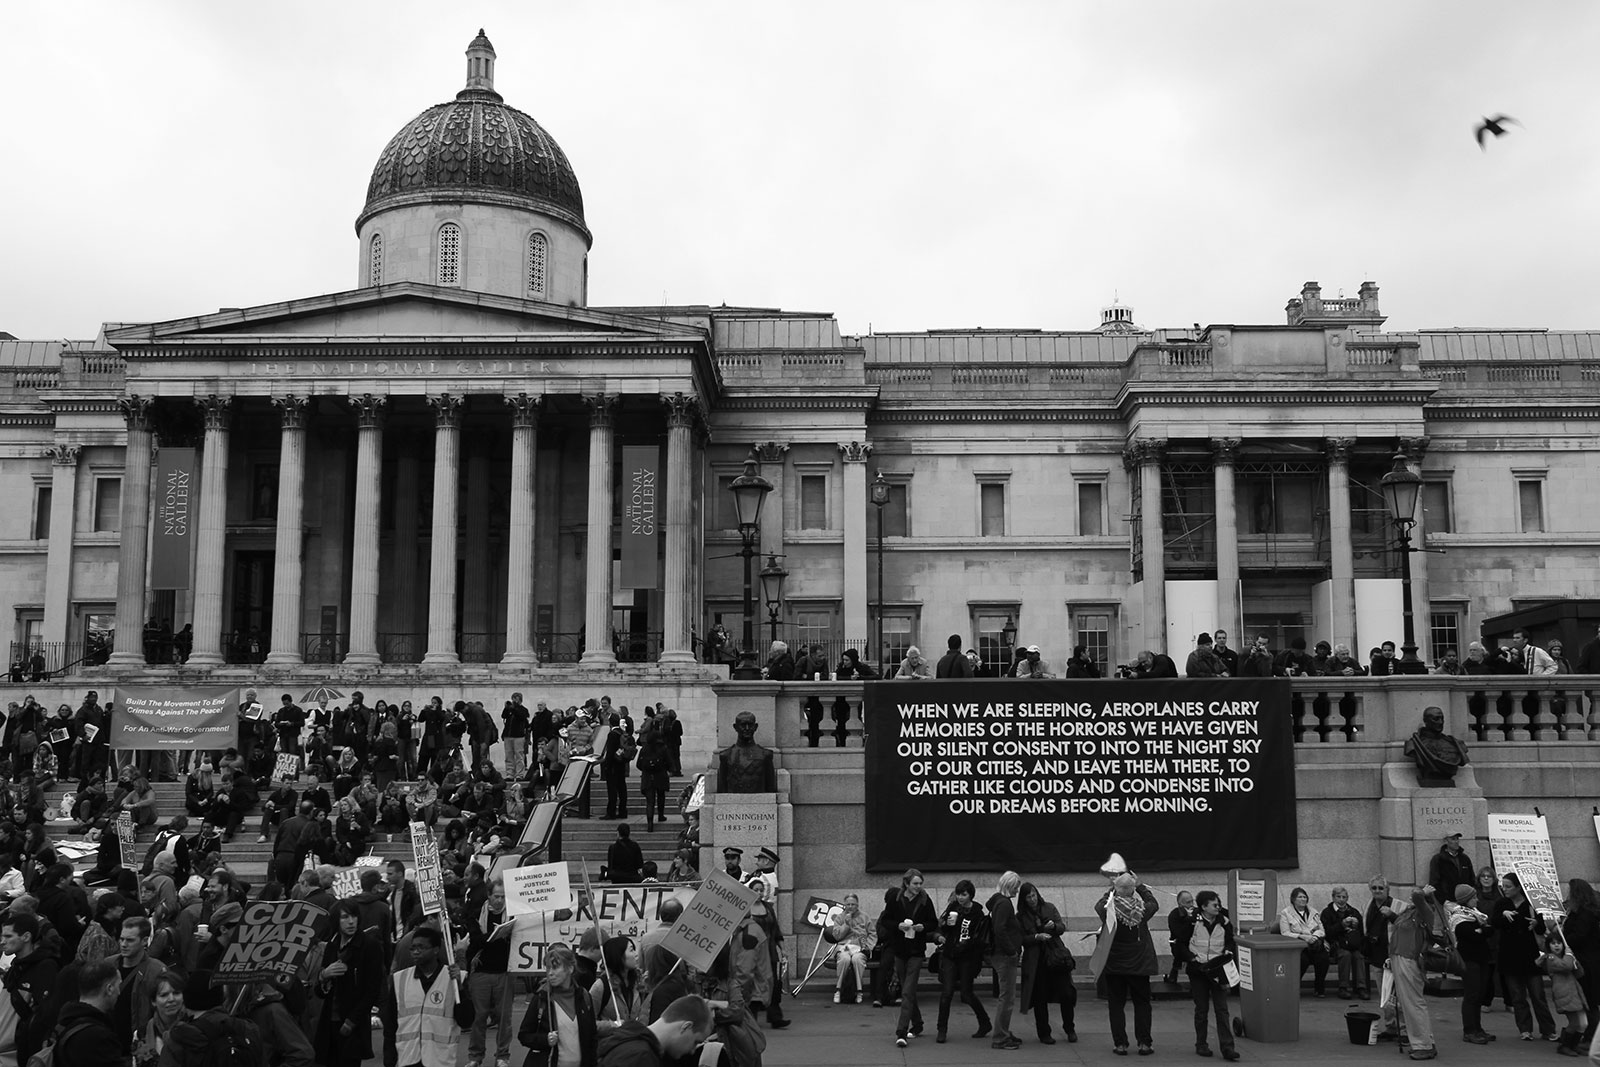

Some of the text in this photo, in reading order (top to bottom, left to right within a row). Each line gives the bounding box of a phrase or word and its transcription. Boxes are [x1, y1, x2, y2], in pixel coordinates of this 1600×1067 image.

[248, 361, 296, 376] THE
[312, 360, 440, 376] NATIONAL
[165, 469, 178, 535] NATIONAL
[175, 470, 189, 536] GALLERY
[632, 468, 643, 535] NATIONAL
[642, 469, 655, 536] GALLERY
[125, 697, 147, 706] Build
[148, 699, 162, 707] The
[212, 697, 226, 705] End
[897, 701, 1260, 720] WHEN WE ARE SLEEPING, AEROPLANES CARRY
[127, 706, 223, 717] Crimes Against The Peace!
[182, 725, 230, 733] Government!
[900, 719, 1258, 738] MEMORIES OF THE HORRORS WE HAVE GIVEN
[897, 739, 1262, 757] OUR SILENT CONSENT TO INTO THE NIGHT SKY
[275, 761, 297, 773] WAR
[277, 753, 300, 765] CUT
[909, 758, 1250, 777] OF OUR CITIES, AND LEAVE THEM THERE, TO
[907, 777, 1254, 795] GATHER LIKE CLOUDS AND CONDENSE INTO
[949, 797, 1213, 814] OUR DREAMS BEFORE MORNING.
[1420, 806, 1466, 816] JELLICOE
[1499, 818, 1534, 827] MEMORIAL
[514, 873, 543, 881] SHARING
[523, 880, 550, 888] JUSTICE
[333, 879, 361, 897] WAR
[535, 887, 556, 895] BRING
[706, 879, 748, 911] SHARING
[244, 902, 328, 928] CUT
[691, 902, 734, 931] JUSTICE
[238, 923, 316, 947] WAR
[676, 923, 717, 954] PEACE
[221, 941, 308, 964] NOT
[219, 960, 299, 975] WELFARE
